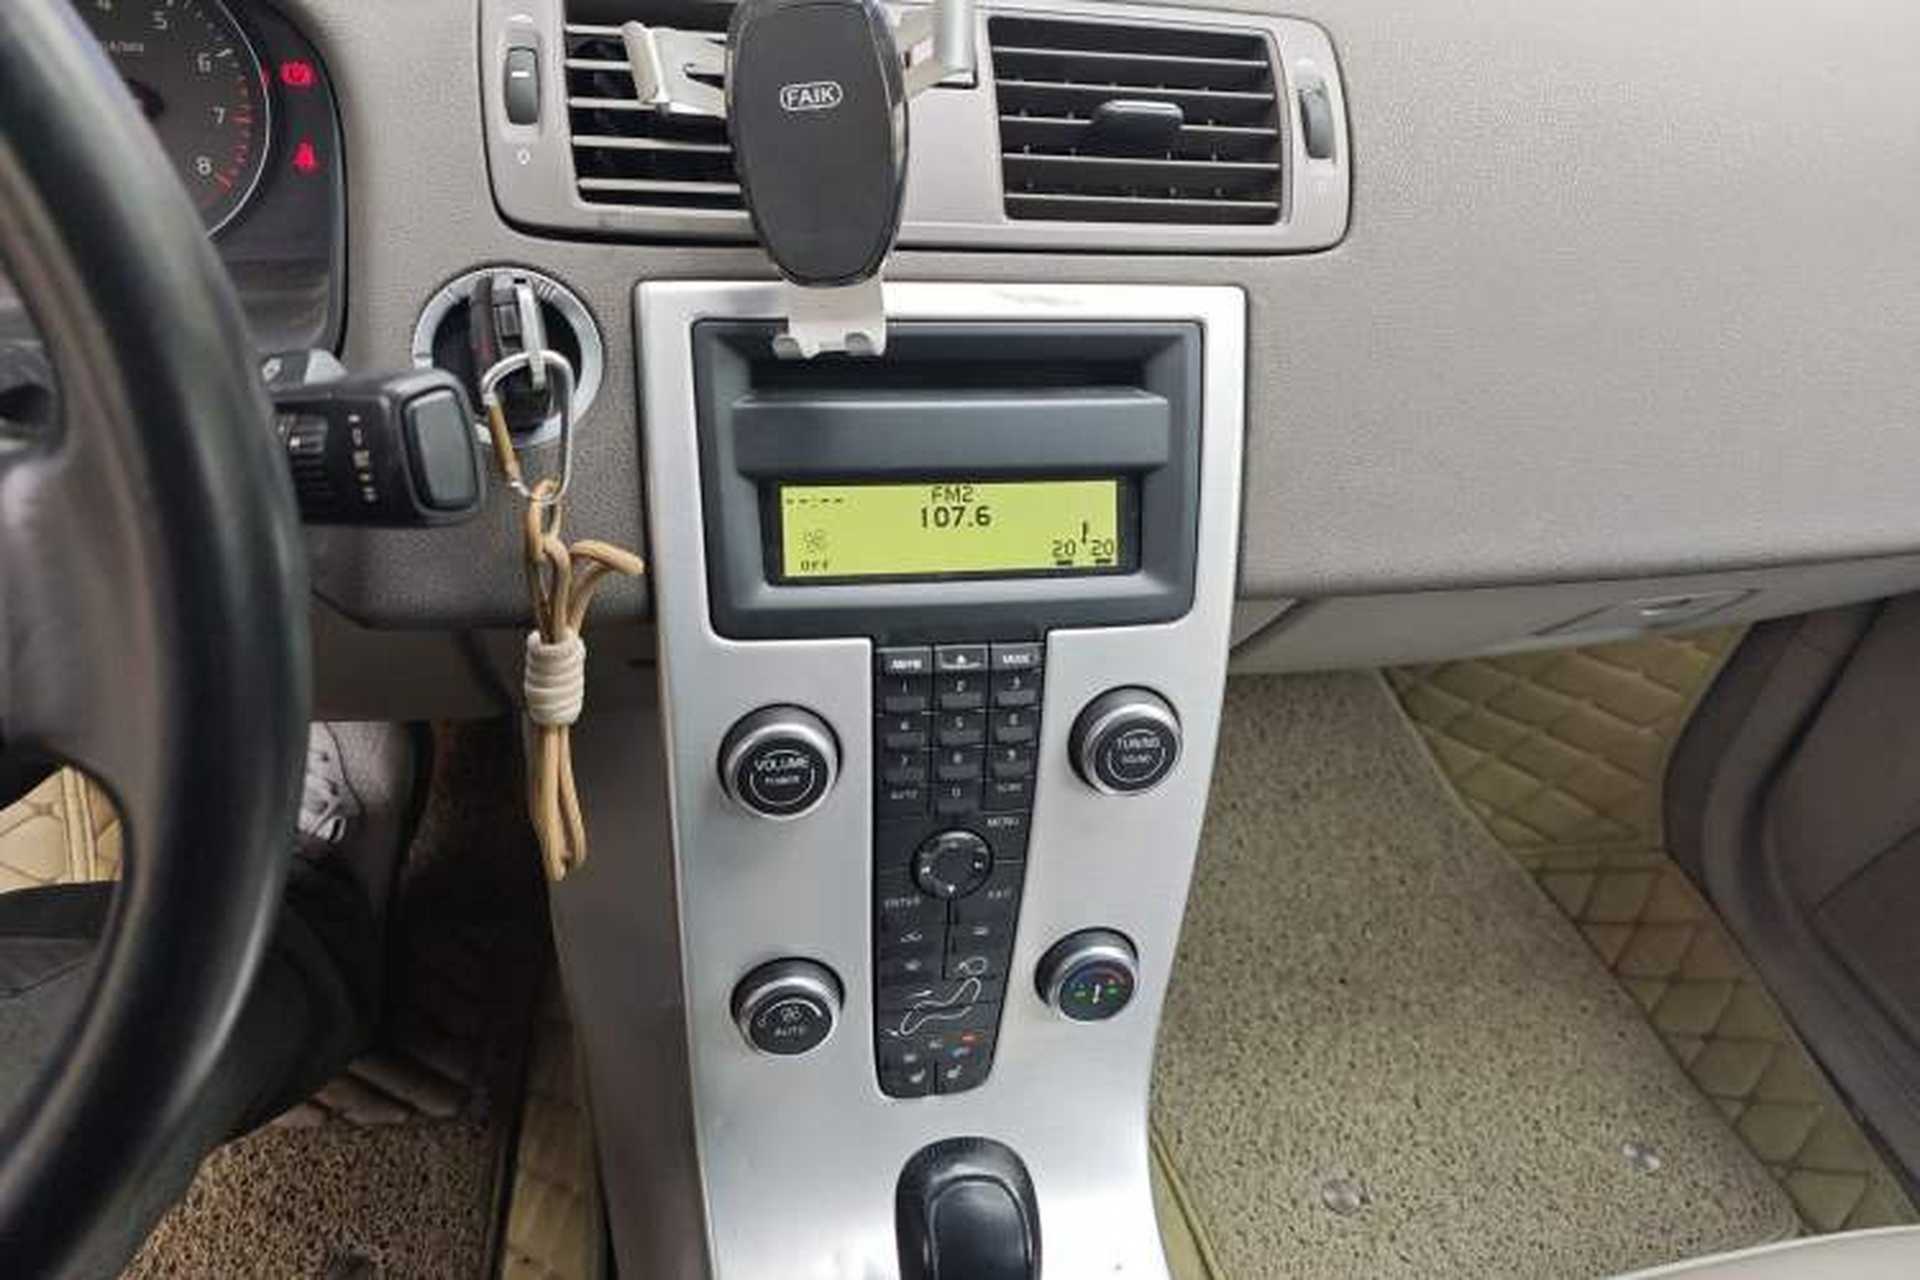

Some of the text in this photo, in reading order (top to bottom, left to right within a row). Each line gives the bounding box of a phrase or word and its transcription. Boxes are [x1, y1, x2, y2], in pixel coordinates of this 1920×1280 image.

[787, 87, 834, 107] FAIK
[213, 106, 225, 124] 7
[196, 156, 212, 175] 8
[931, 486, 975, 502] FM2
[920, 506, 991, 528] 107.6
[1052, 539, 1076, 558] 20
[1091, 539, 1115, 557] 20
[754, 755, 809, 771] VOLUME
